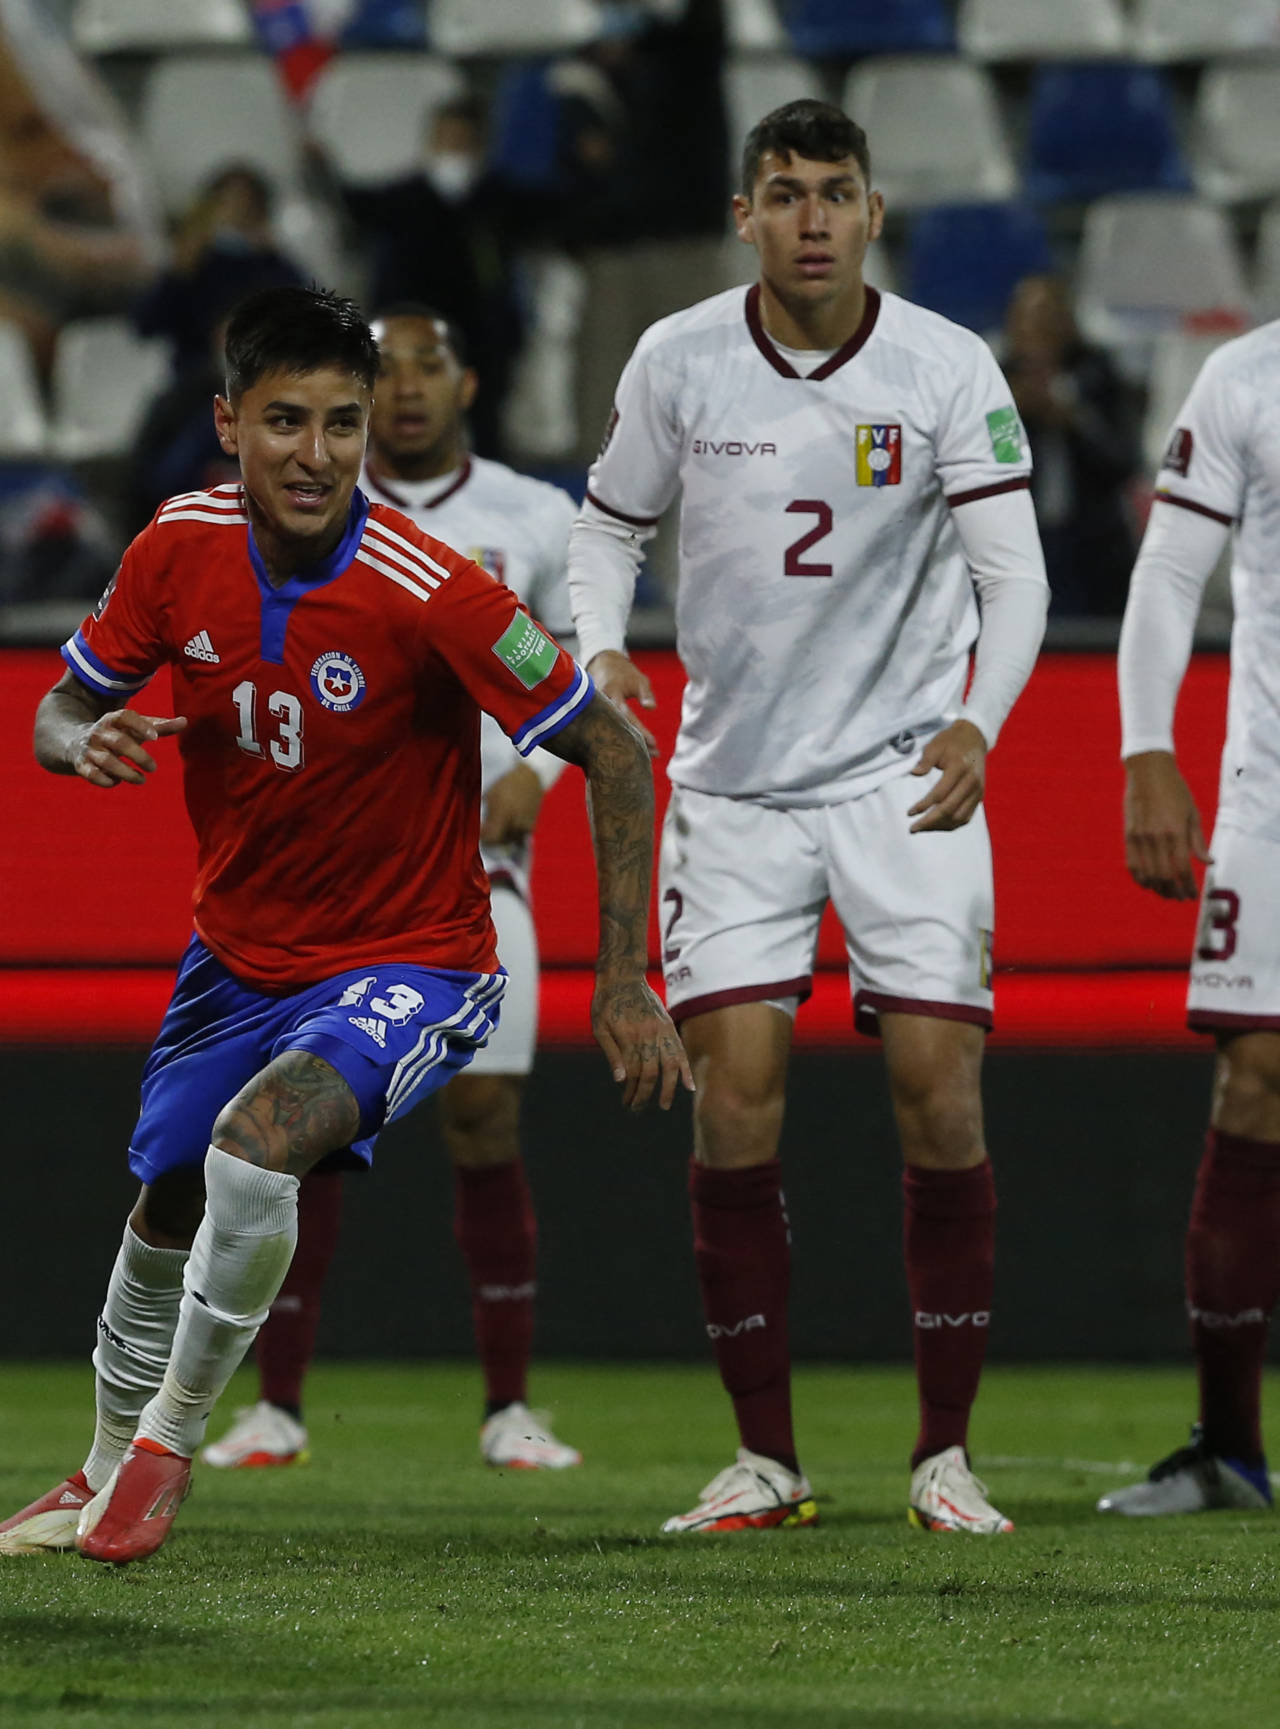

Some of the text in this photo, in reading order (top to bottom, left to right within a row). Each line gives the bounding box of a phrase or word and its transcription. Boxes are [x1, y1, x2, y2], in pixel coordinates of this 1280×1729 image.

[693, 440, 777, 456] GIVOVA
[858, 428, 899, 446] FVF
[784, 499, 833, 577] 2
[183, 646, 221, 664] adidas
[232, 680, 305, 773] 13
[662, 887, 683, 964] 2
[336, 976, 425, 1027] 13
[347, 1016, 387, 1049] adidas
